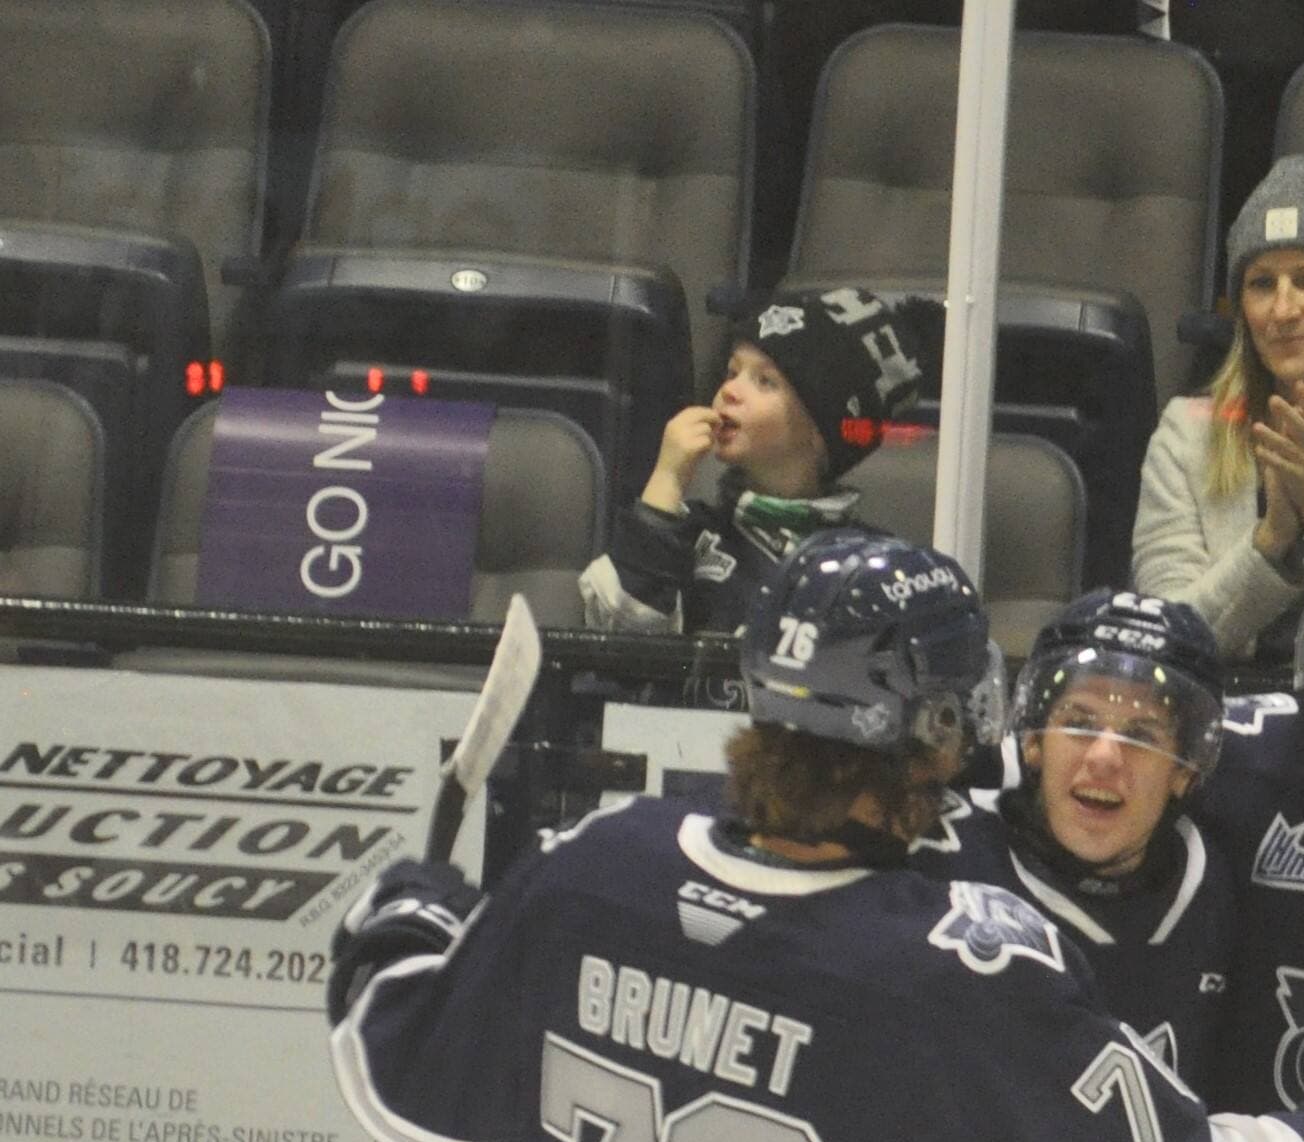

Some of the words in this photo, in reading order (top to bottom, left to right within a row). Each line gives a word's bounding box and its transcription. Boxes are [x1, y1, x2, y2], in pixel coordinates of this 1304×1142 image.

[300, 486, 368, 598] GO
[0, 742, 415, 797] NETTOYAGE
[0, 804, 393, 862] UCTION
[43, 865, 297, 911] SOUCY
[677, 880, 768, 920] CCM
[0, 932, 64, 967] cial
[121, 940, 328, 985] 418.724.202
[578, 954, 813, 1097] BRUNET
[69, 1076, 160, 1111] RÉSEAU
[168, 1089, 198, 1112] DE
[0, 1112, 83, 1140] NNELS
[91, 1117, 121, 1142] DE
